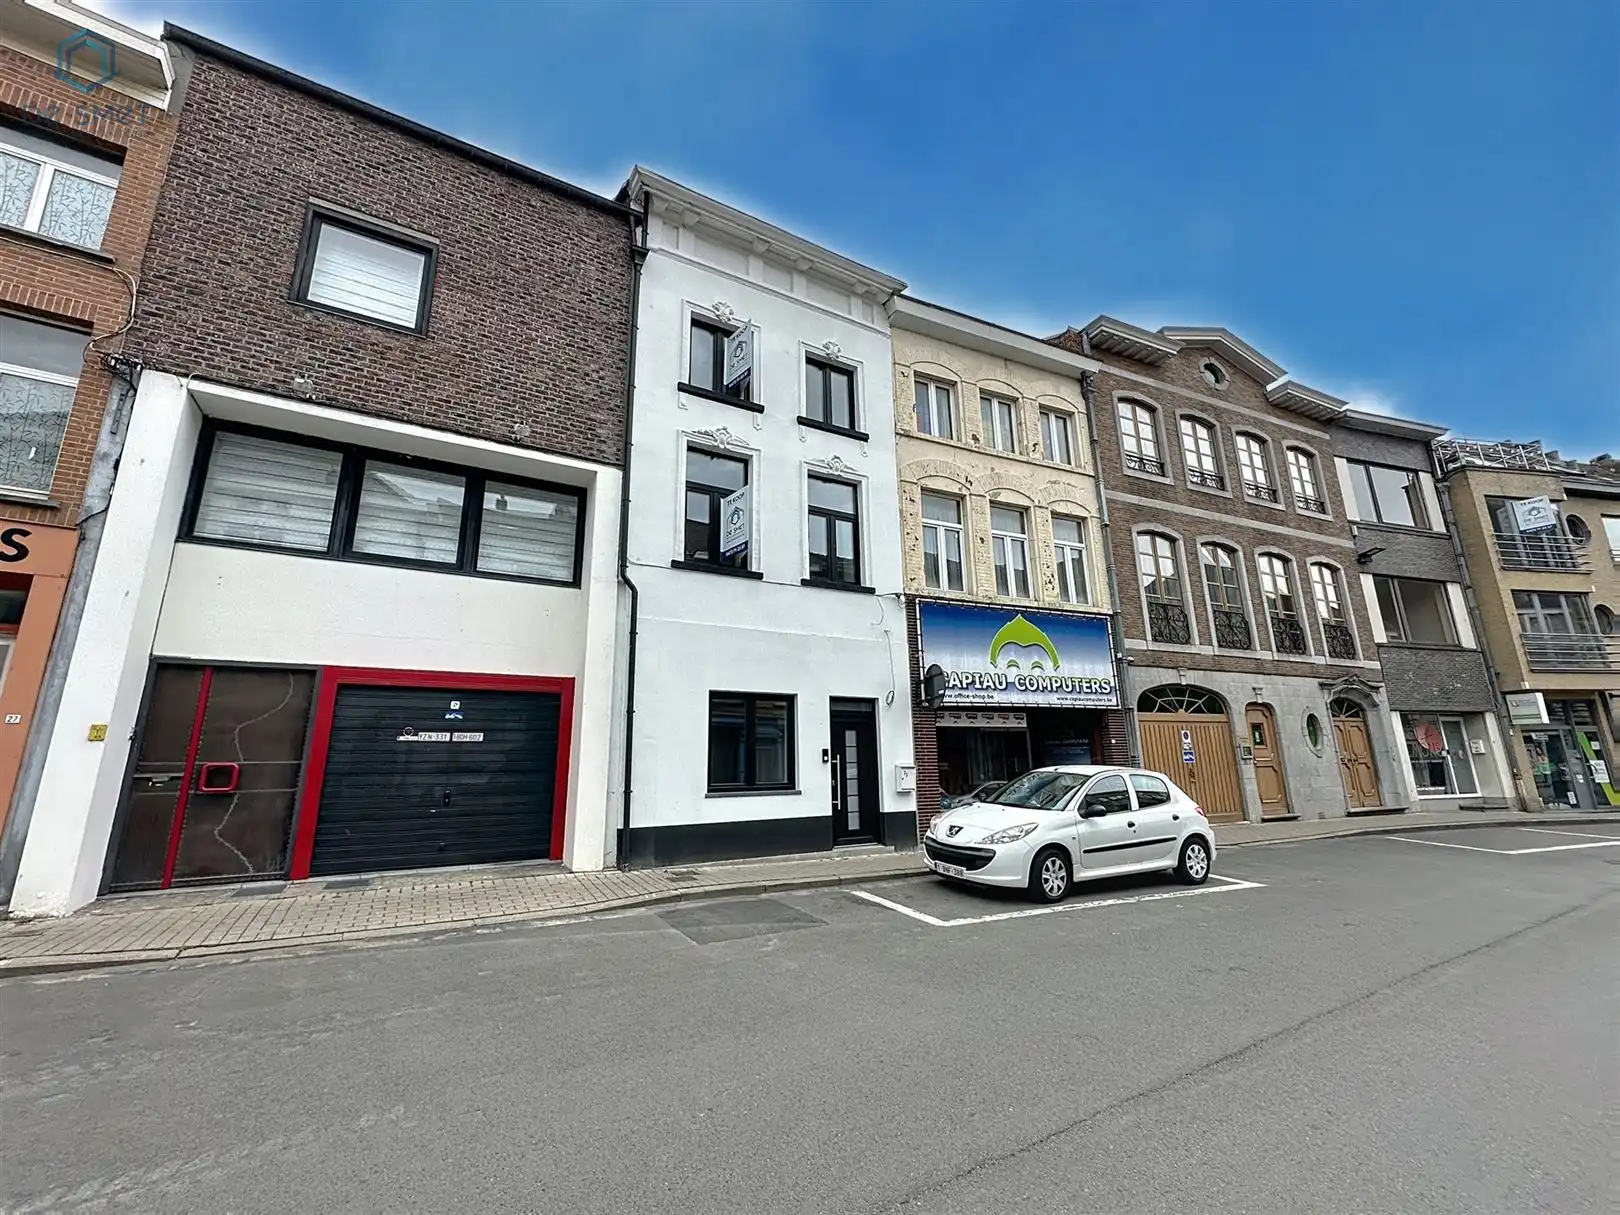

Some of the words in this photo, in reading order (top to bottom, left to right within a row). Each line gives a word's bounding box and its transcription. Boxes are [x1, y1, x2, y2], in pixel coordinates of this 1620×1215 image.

[0, 527, 32, 562] S
[1013, 673, 1112, 694] COMPUTERS
[7, 715, 18, 723] 27
